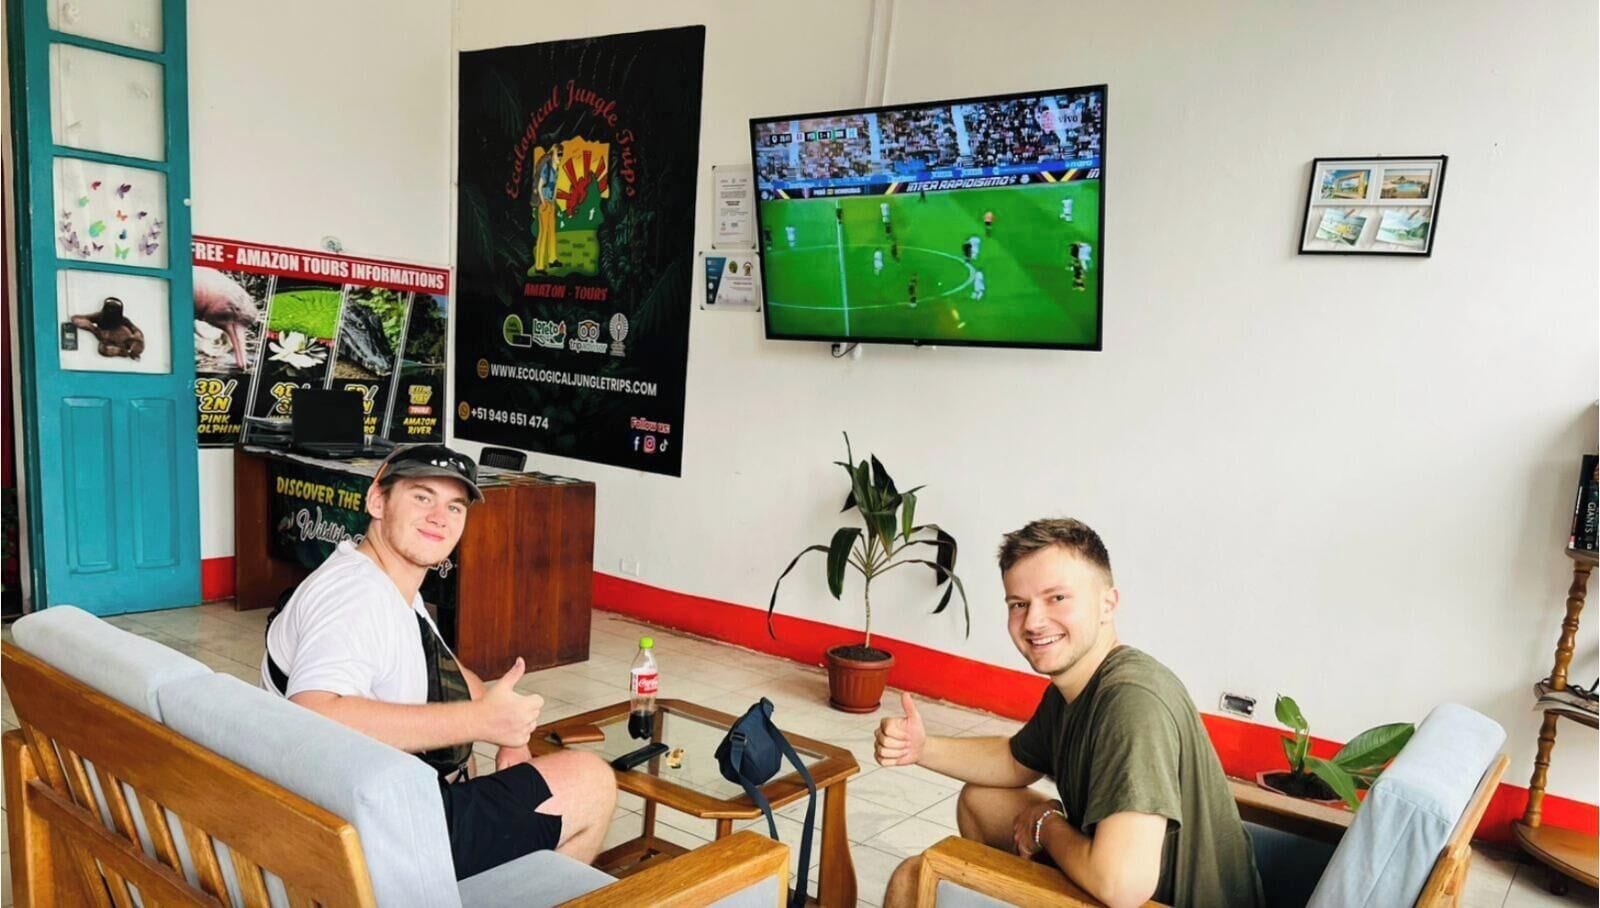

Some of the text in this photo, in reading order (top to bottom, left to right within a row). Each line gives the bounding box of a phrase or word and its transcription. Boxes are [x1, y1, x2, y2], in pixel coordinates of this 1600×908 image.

[506, 85, 560, 200] Ecological
[565, 79, 619, 128] Jungle
[236, 248, 300, 272] AMAZON
[302, 256, 349, 278] TOURS
[351, 263, 444, 290] INFORMATIONS
[524, 283, 565, 298] AMAZON
[575, 285, 608, 301] TOURS
[490, 363, 657, 397] WWW.ECOLOGICALJUNGLETRIPS.COM
[199, 396, 232, 413] 2N
[200, 414, 231, 424] PINK
[403, 417, 437, 426] AMAZON
[471, 407, 549, 429] +51 949 651 474
[197, 423, 241, 434] OLPHIN
[408, 426, 432, 435] RIVER
[276, 476, 335, 506] DISCOVER
[337, 489, 362, 512] THE
[1585, 502, 1597, 533] GIANTS
